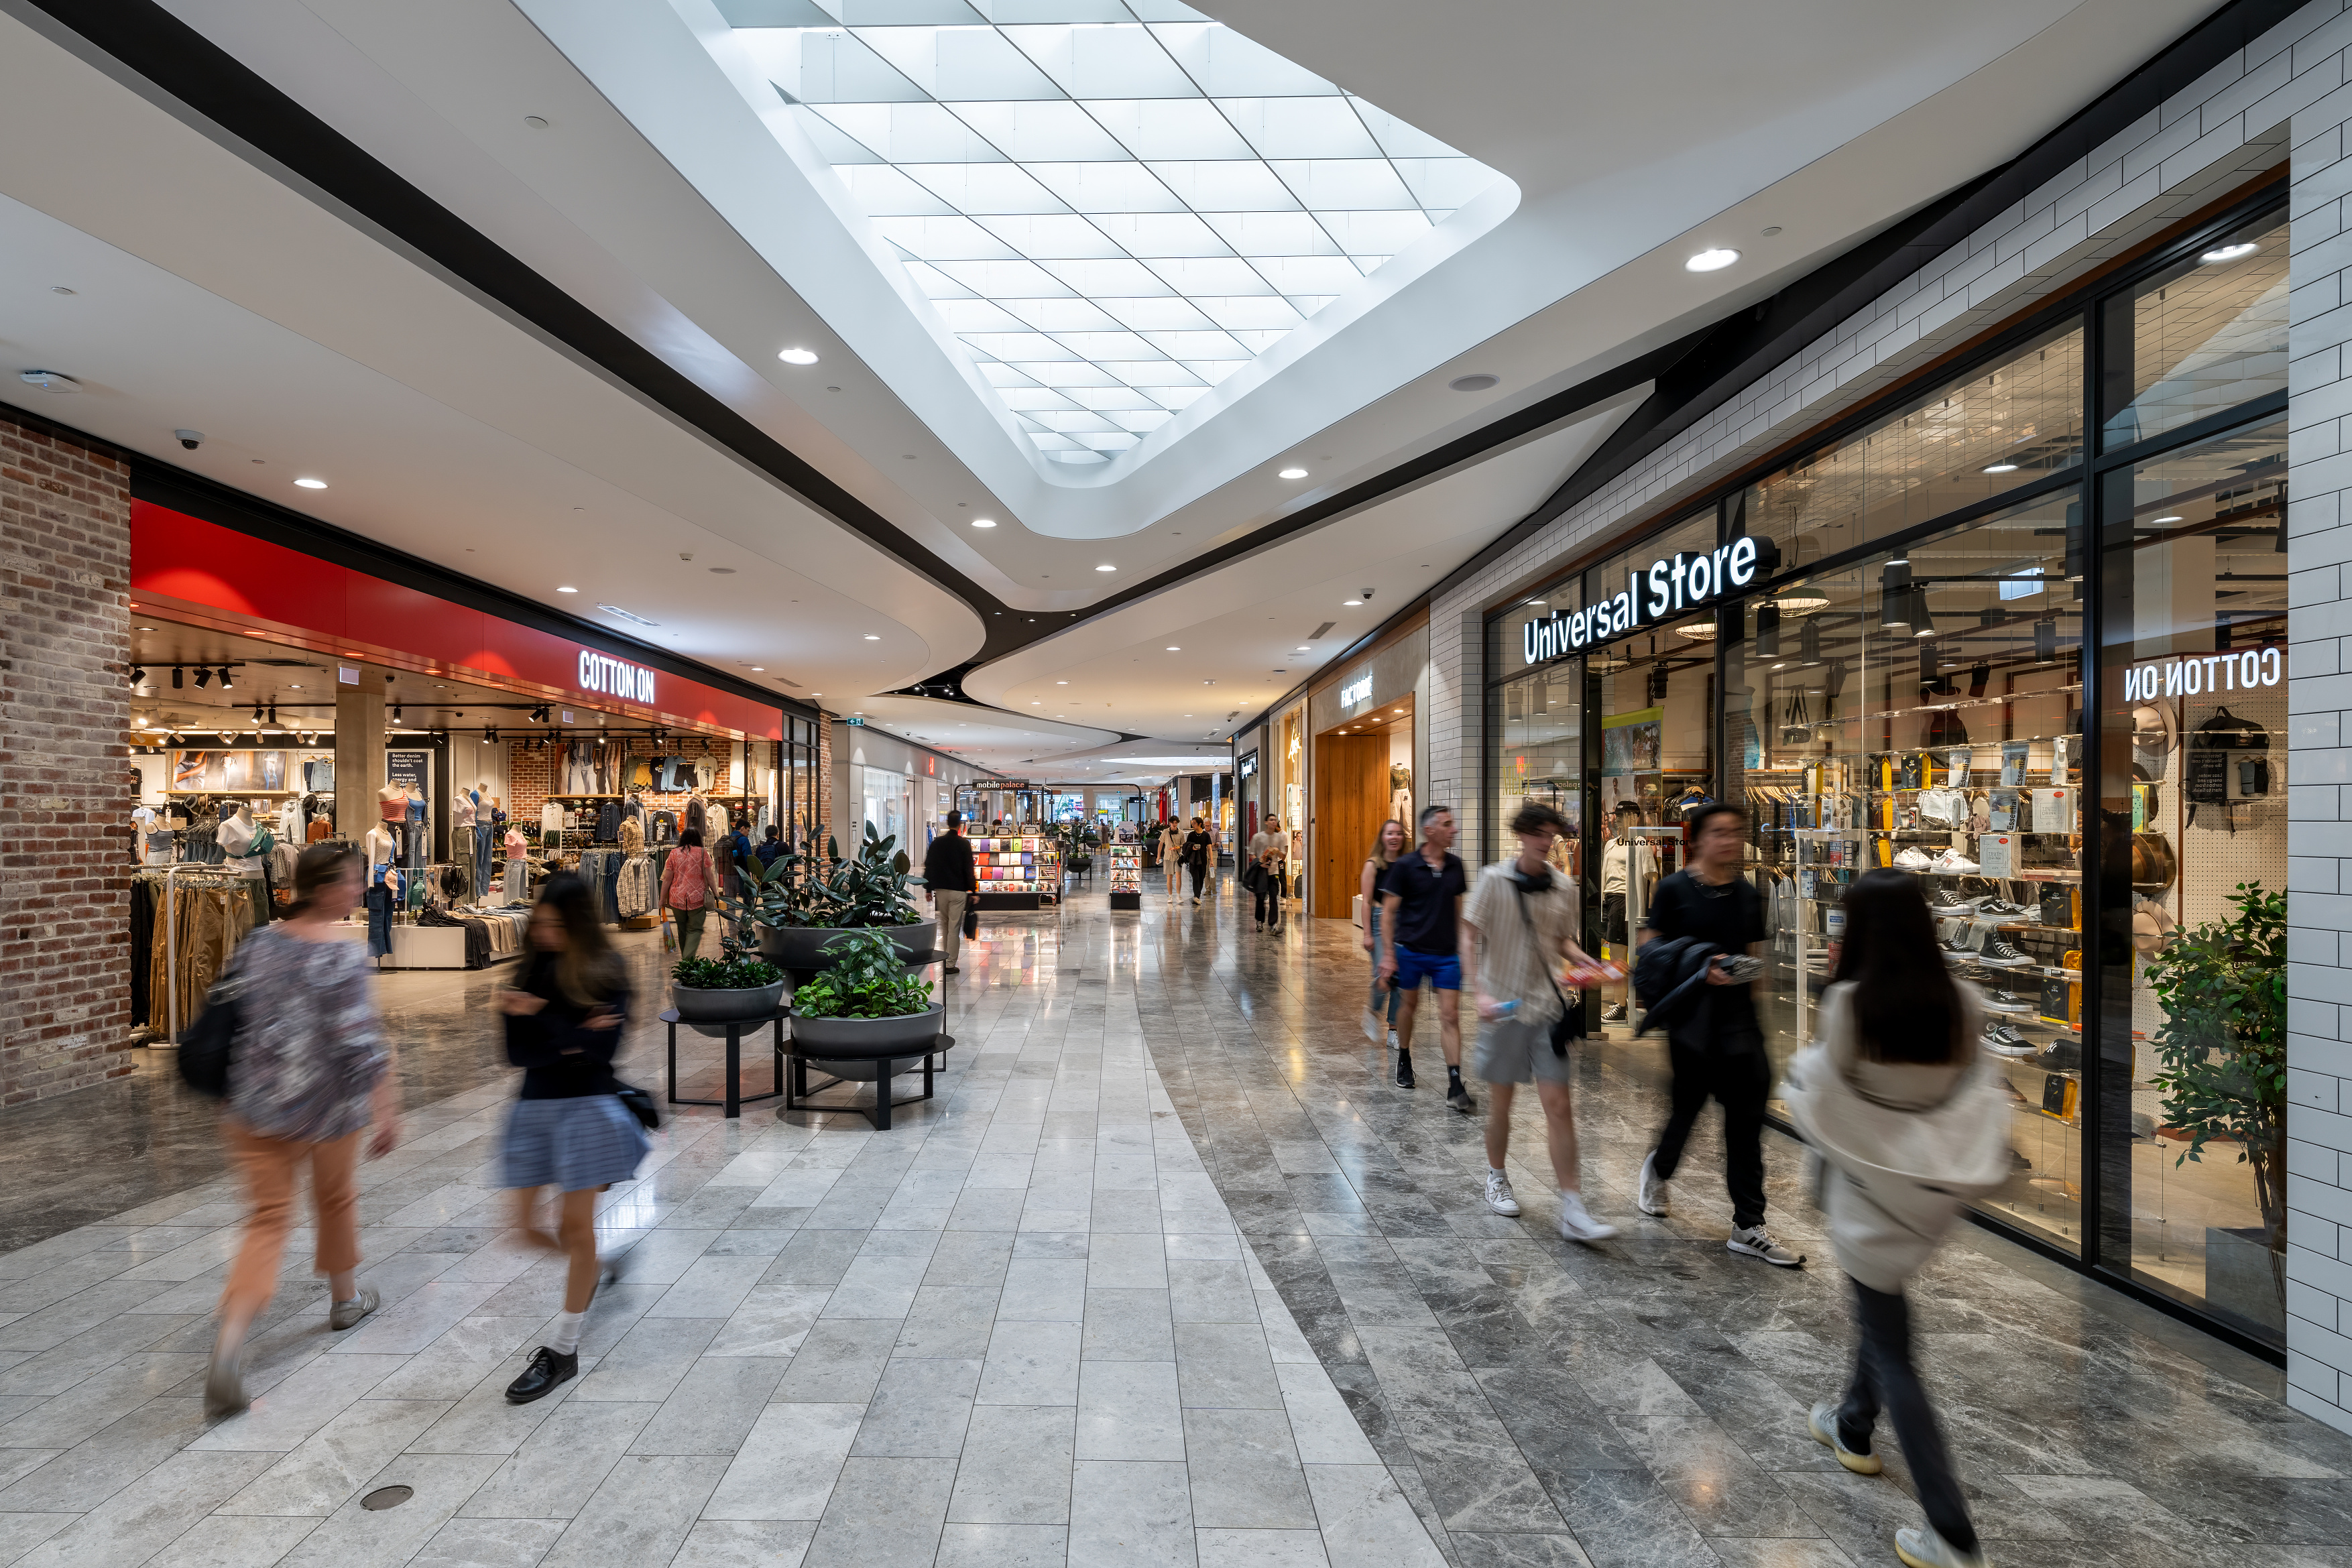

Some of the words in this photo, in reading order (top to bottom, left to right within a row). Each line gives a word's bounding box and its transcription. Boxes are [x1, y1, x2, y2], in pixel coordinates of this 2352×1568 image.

[1524, 570, 1637, 664] Universal
[1648, 537, 1756, 617] Store
[579, 650, 635, 699] COTTON
[637, 668, 654, 703] ON
[1958, 758, 1971, 787] Essential
[2015, 755, 2026, 786] Essential
[2007, 799, 2017, 830] Essential
[1616, 838, 1665, 846] Universal
